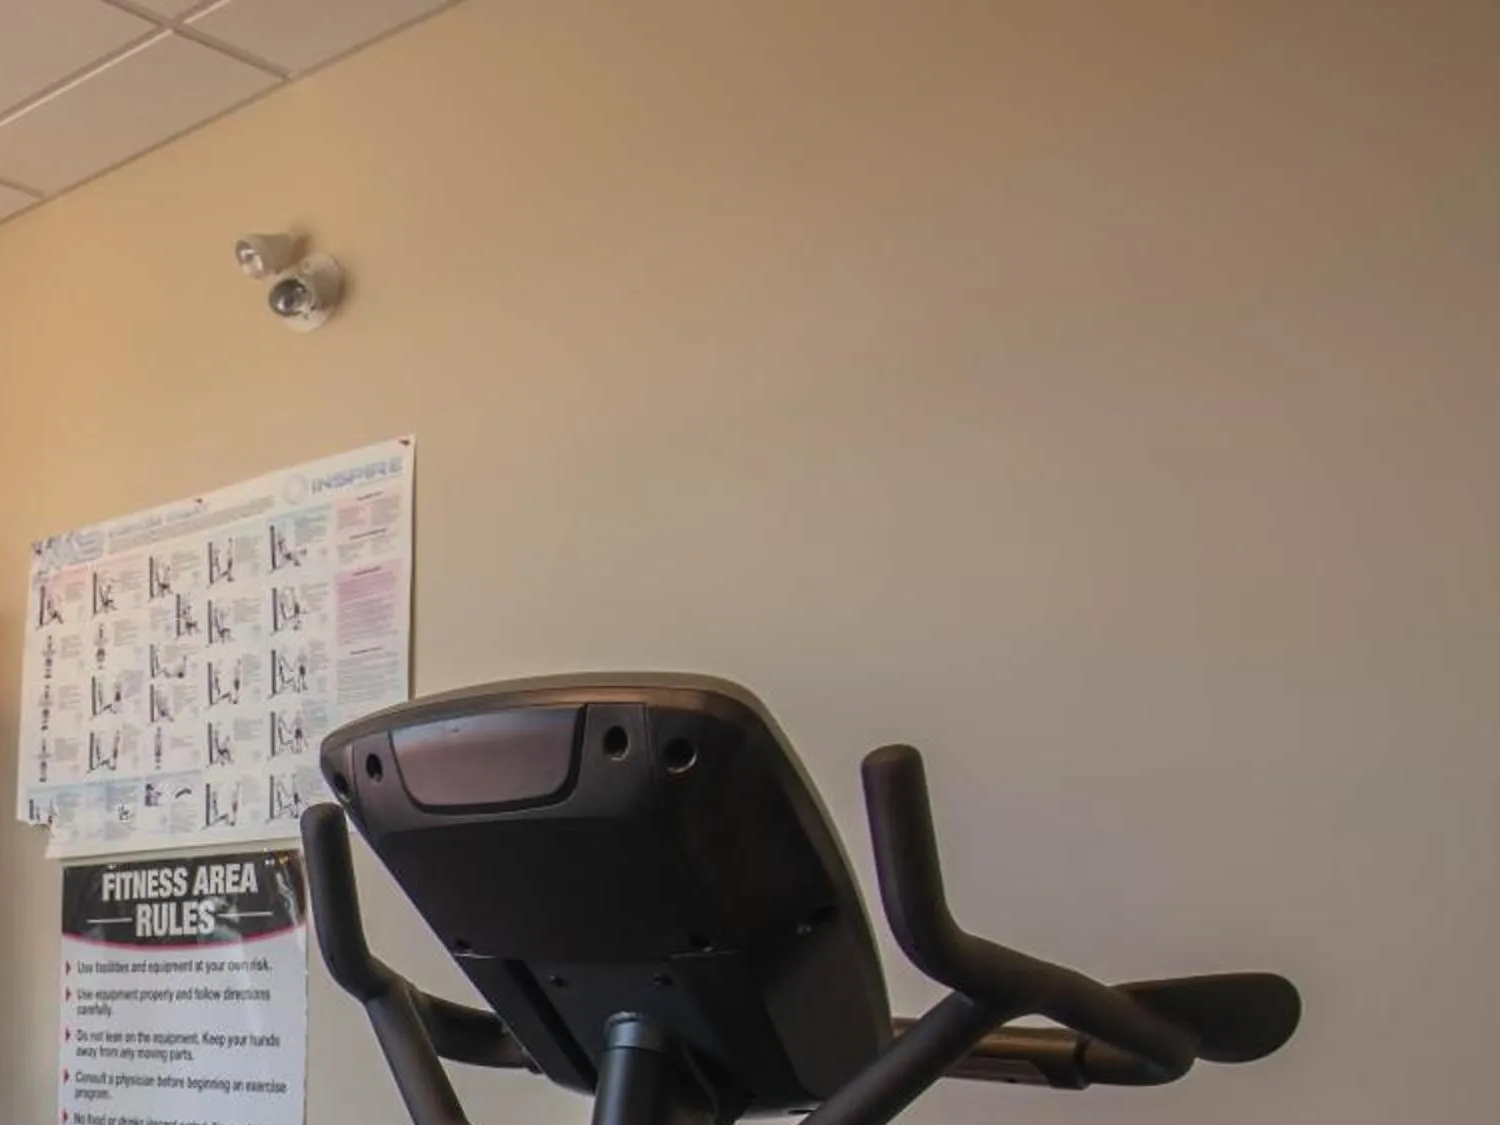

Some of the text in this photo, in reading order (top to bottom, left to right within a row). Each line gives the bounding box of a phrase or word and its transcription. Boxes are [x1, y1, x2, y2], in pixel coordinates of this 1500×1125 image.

[311, 456, 403, 494] INSPIRE
[102, 862, 258, 900] FITNESS AREA
[136, 901, 217, 937] RULES
[77, 960, 93, 973] Use
[132, 960, 146, 973] and
[148, 960, 193, 975] equipment
[205, 961, 225, 975] your
[228, 961, 249, 972] own
[77, 986, 271, 1003] Use equipment properly and follow directions
[90, 1030, 104, 1042] not
[106, 1031, 122, 1043] lean
[138, 1031, 150, 1043] the
[202, 1031, 225, 1048] Keep
[227, 1035, 247, 1049] your
[249, 1033, 281, 1048] hands
[99, 1046, 119, 1057] from
[121, 1048, 135, 1061] any
[137, 1049, 168, 1063] moving
[170, 1050, 194, 1062] parts.
[76, 1071, 107, 1085] Consult
[116, 1073, 155, 1088] physician
[157, 1075, 185, 1089] before
[187, 1077, 231, 1094] beginning
[246, 1080, 287, 1094] exercise
[73, 1112, 85, 1125] No
[87, 1113, 106, 1125] food
